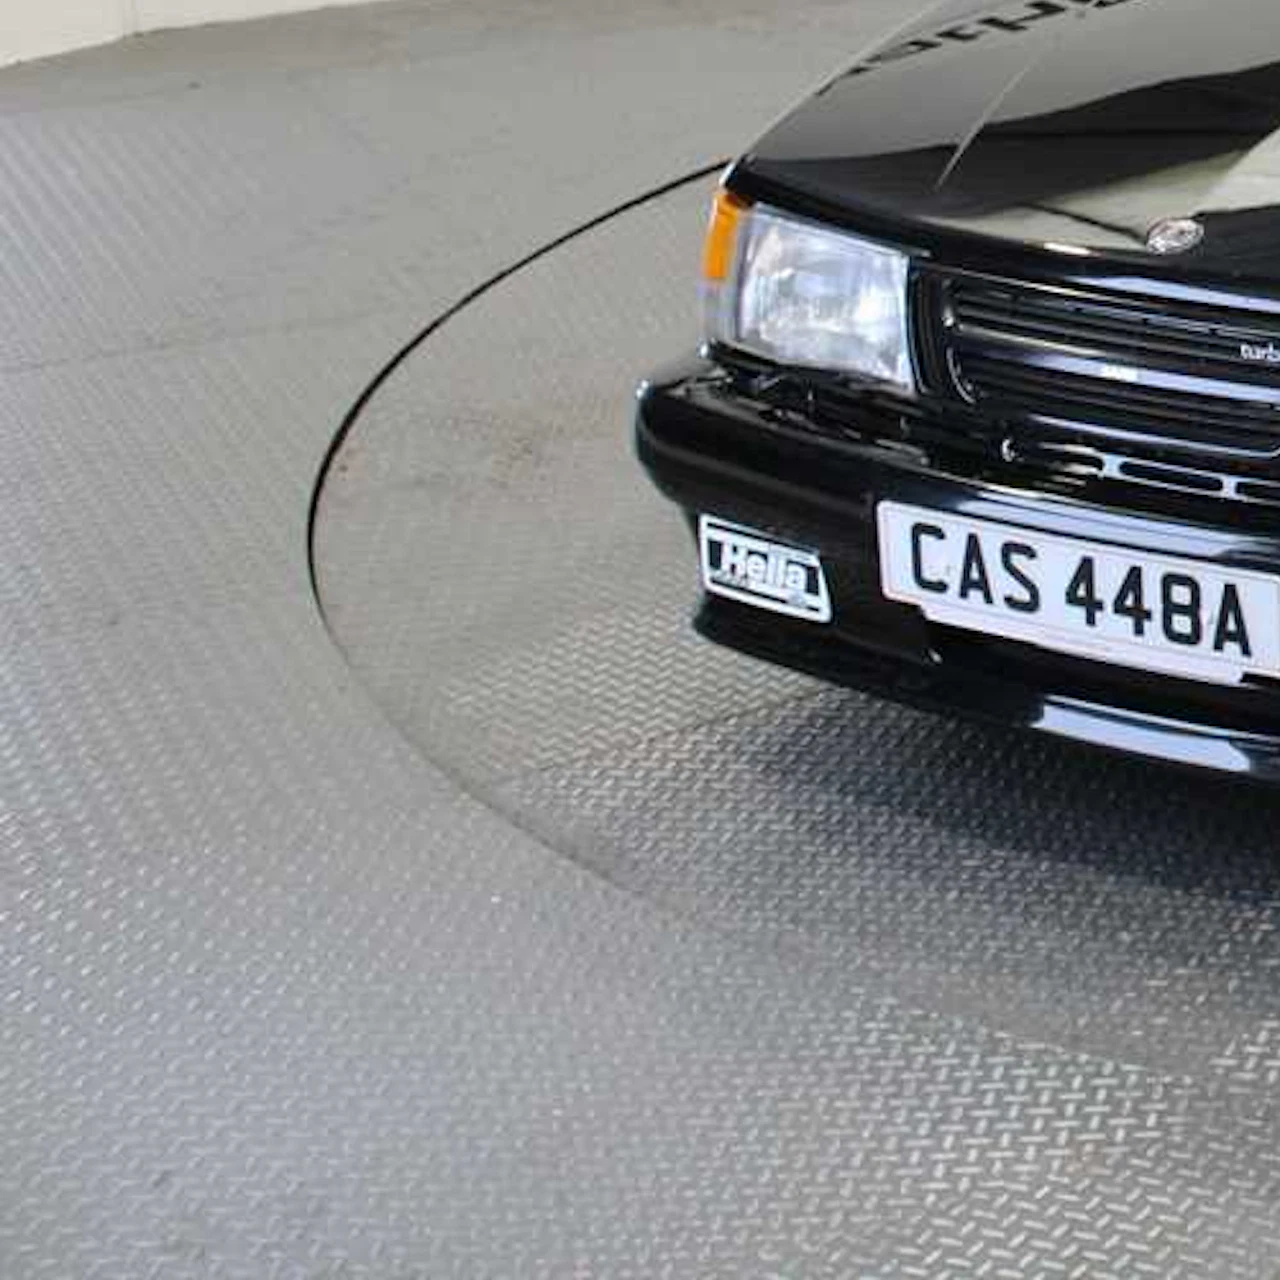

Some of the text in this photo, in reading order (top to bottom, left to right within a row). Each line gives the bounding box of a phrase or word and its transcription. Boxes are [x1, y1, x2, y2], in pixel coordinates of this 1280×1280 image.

[720, 540, 806, 594] Hella
[911, 522, 1252, 658] CAS 448A
